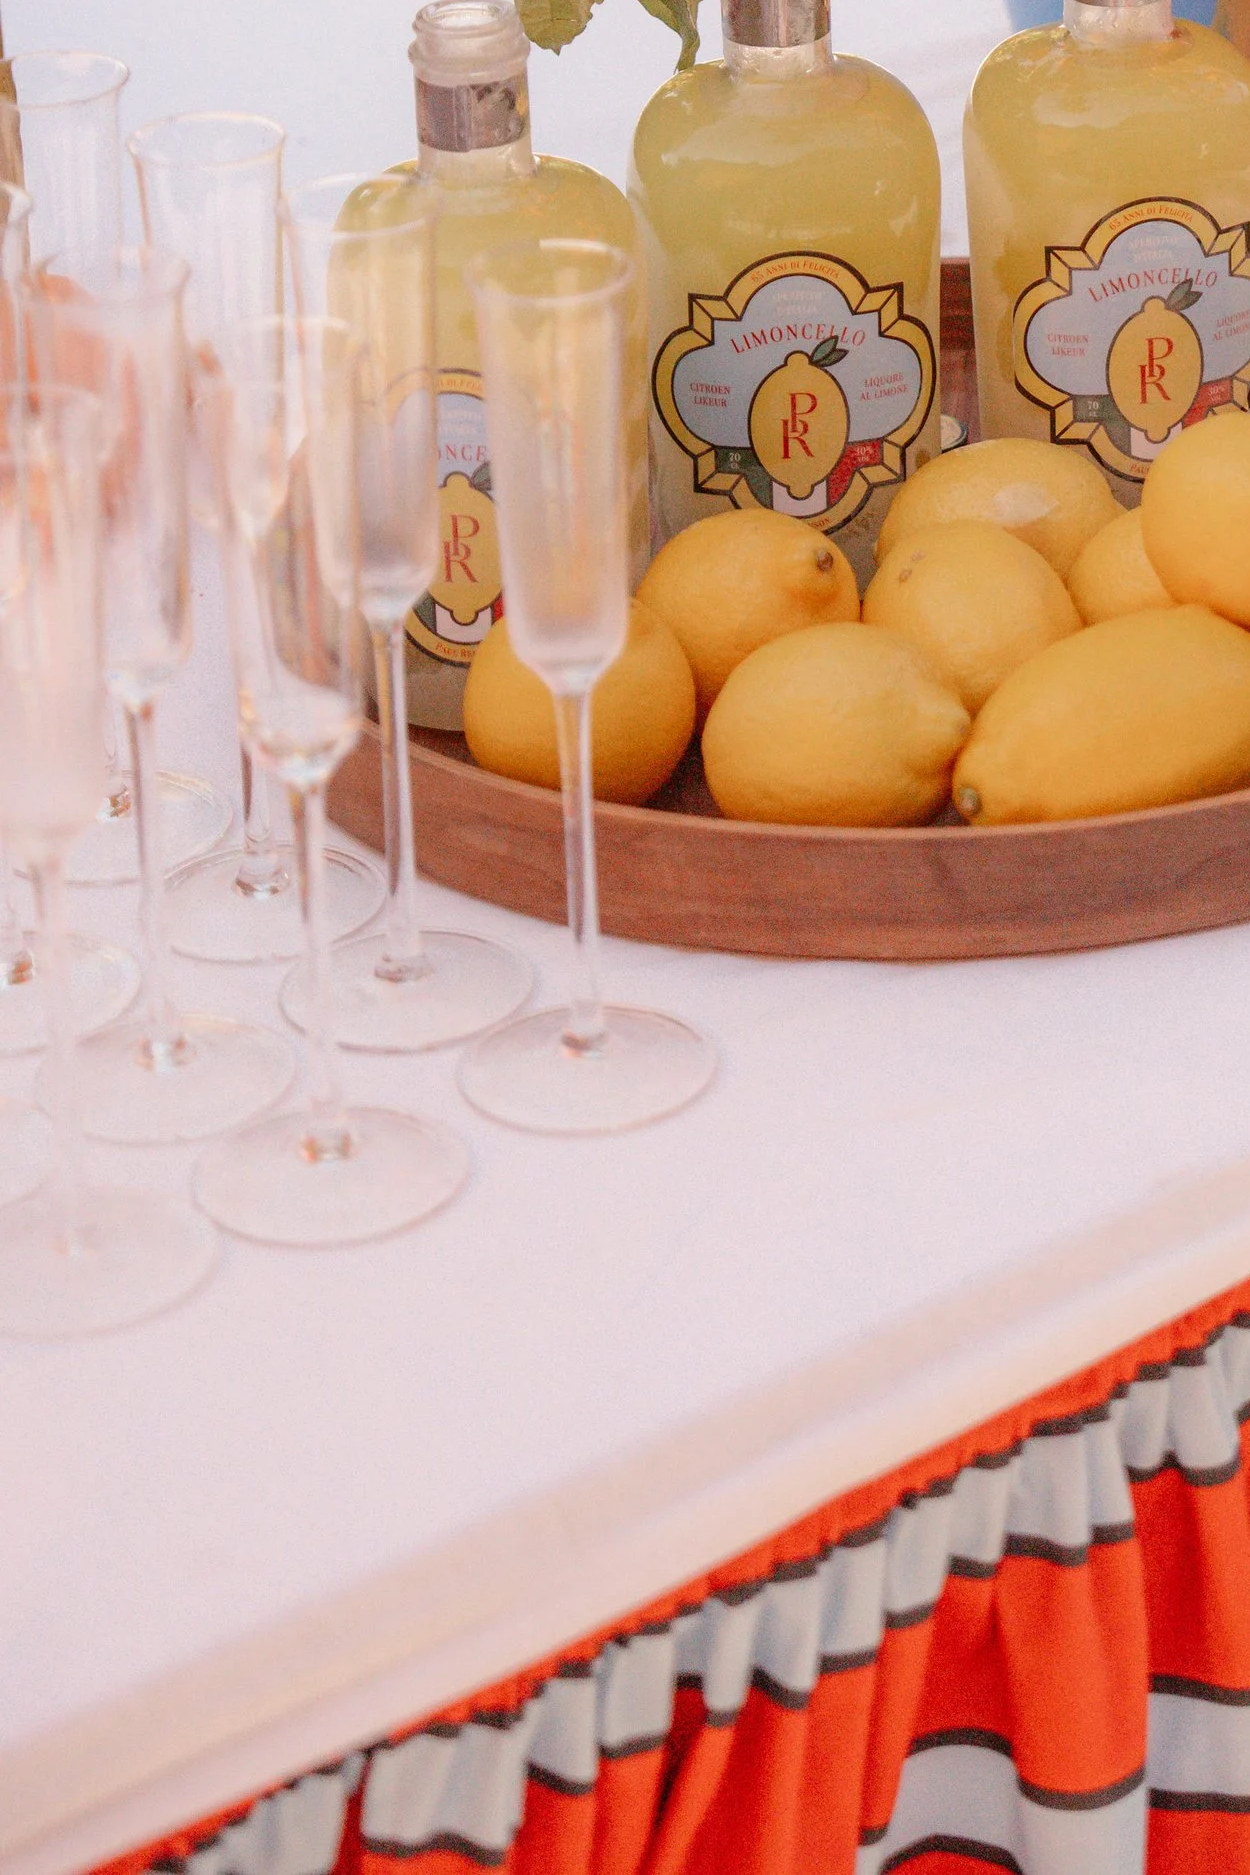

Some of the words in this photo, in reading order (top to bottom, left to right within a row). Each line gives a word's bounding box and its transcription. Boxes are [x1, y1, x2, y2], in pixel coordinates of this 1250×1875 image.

[1088, 267, 1218, 302] LIMONCELLO
[730, 323, 867, 354] LIMONCELLO
[1047, 333, 1089, 344] CITROEN
[1052, 346, 1086, 357] LIKEUR
[863, 372, 905, 388] LIQUORE
[689, 382, 732, 395] CITROEN
[859, 391, 871, 402] AL
[873, 383, 910, 399] LIMONE
[694, 395, 728, 408] LIKEUR
[1087, 401, 1099, 410] 70
[729, 452, 741, 462] 70
